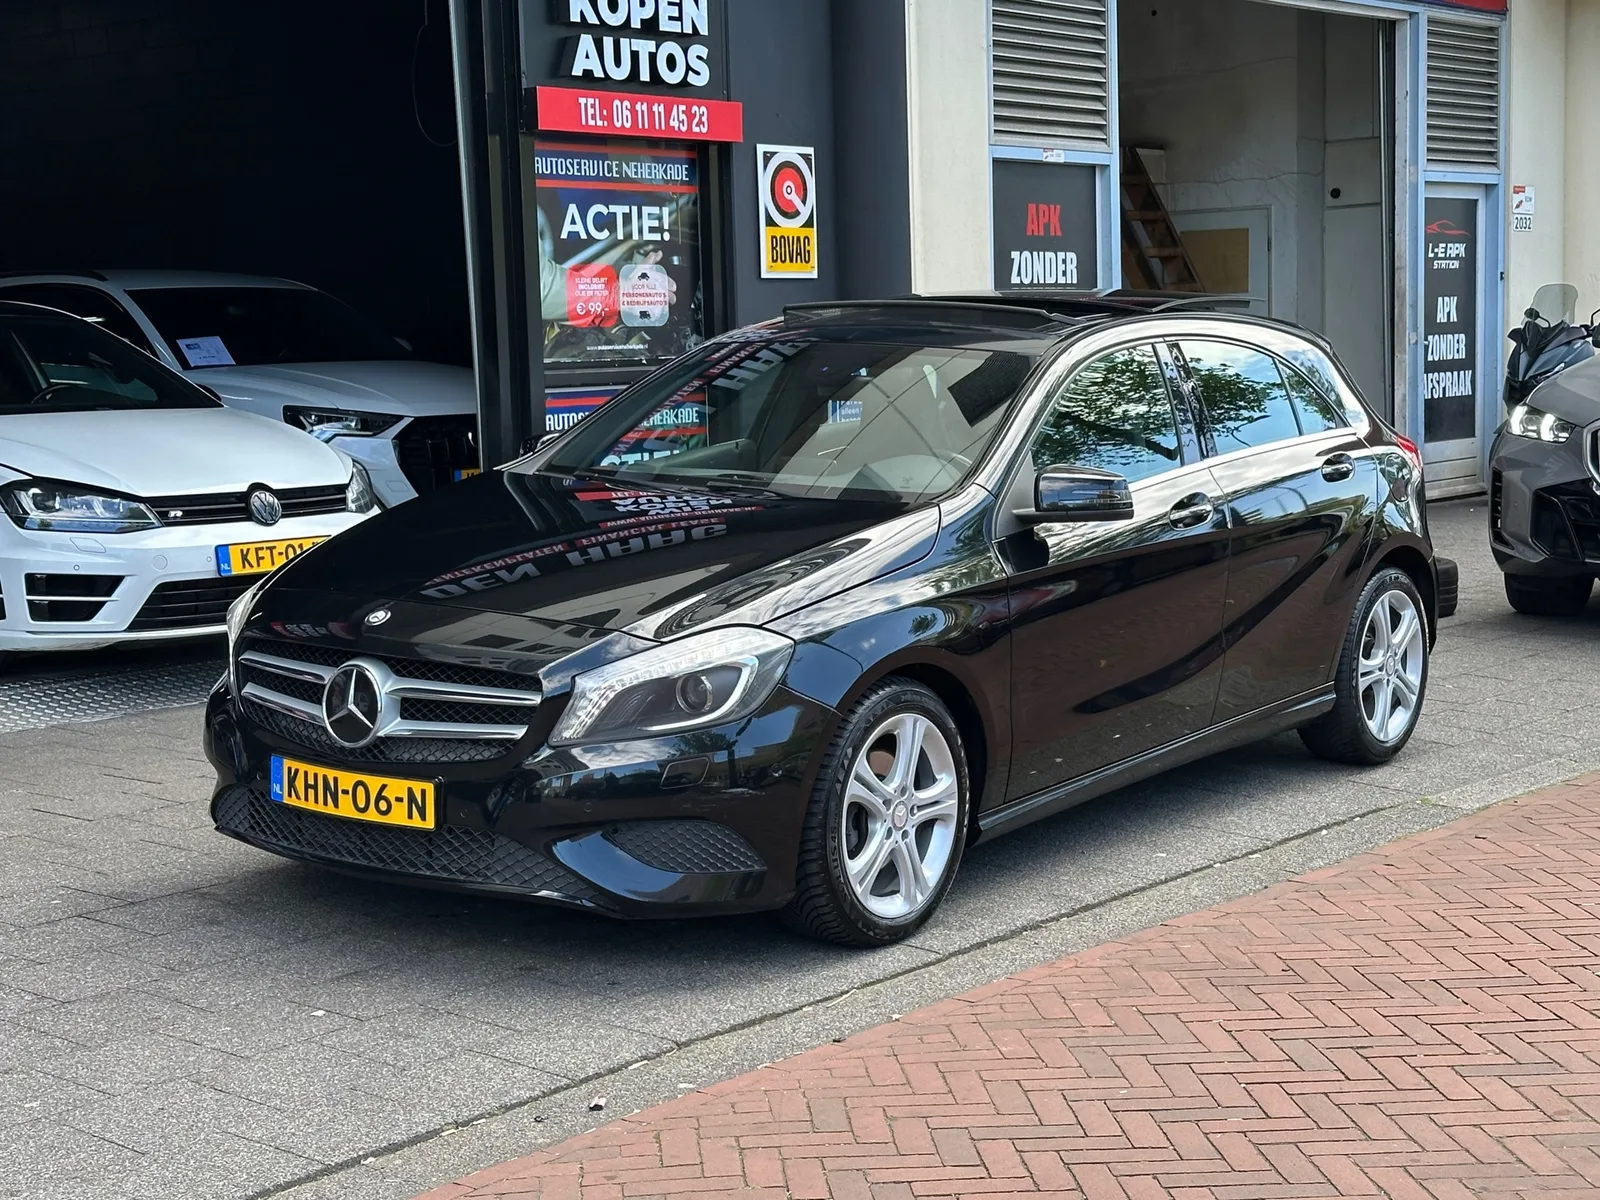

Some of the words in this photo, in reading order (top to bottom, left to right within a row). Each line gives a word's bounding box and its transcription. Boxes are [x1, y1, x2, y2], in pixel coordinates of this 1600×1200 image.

[569, 0, 709, 35] KOPEN
[571, 34, 710, 86] AUTOS
[578, 97, 608, 127] TEL:
[613, 100, 632, 128] 06
[636, 101, 649, 129] 11
[652, 103, 665, 130] 11
[669, 104, 687, 132] 45
[691, 105, 708, 134] 23
[534, 157, 620, 178] AUTOSERVICE
[622, 161, 689, 181] NEHERKADE
[560, 203, 671, 241] ACTIE!
[1026, 203, 1062, 236] APK
[1514, 216, 1532, 230] 2032
[770, 235, 811, 264] BOVAG
[1010, 251, 1078, 284] ZONDER
[1433, 260, 1460, 269] STATION
[576, 302, 586, 315] €
[1436, 296, 1458, 323] APK
[1427, 333, 1466, 361] ZONDER
[1424, 370, 1473, 399] AFSPRAAK
[273, 783, 282, 794] NL
[287, 766, 427, 822] KHN-06-N
